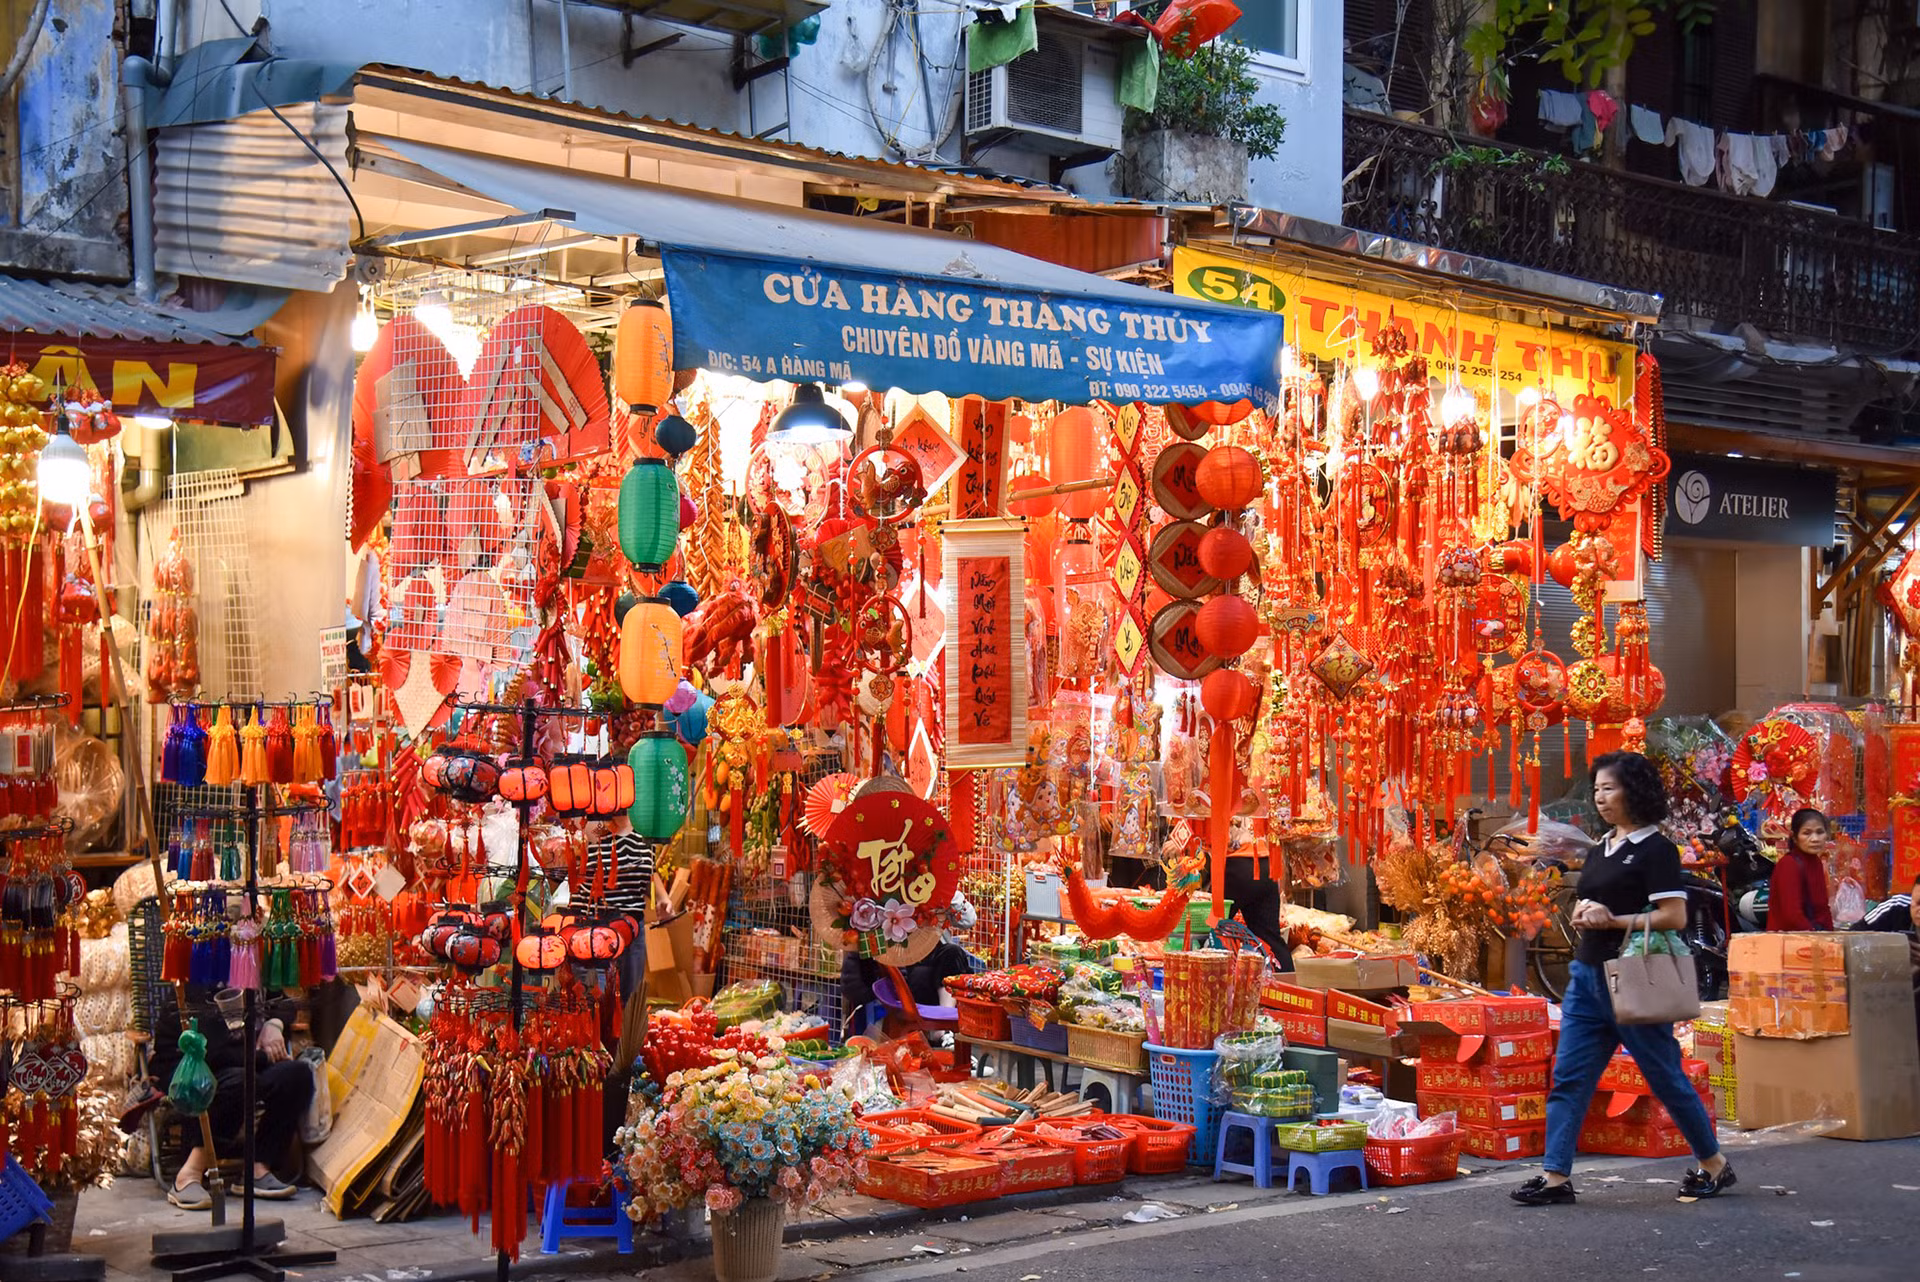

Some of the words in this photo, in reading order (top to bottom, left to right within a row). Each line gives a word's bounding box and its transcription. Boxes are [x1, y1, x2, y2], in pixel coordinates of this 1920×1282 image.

[763, 265, 851, 311] CỬA
[860, 279, 974, 323] HÀNG
[1202, 269, 1276, 311] 54
[1300, 295, 1495, 366] THANH
[708, 350, 738, 371] Đ/C:
[741, 355, 761, 373] 54
[766, 357, 777, 375] A
[781, 354, 826, 379] HÀNG
[829, 361, 852, 381] MÃ
[842, 325, 929, 359] CHUYÊN
[934, 327, 962, 362] ĐỒ
[967, 334, 1026, 367] VÀNG
[1030, 341, 1064, 370] MÃ
[1086, 345, 1112, 377] SỰ
[1117, 347, 1165, 380] KIỆN
[1089, 381, 1112, 398] ĐT:
[1114, 383, 1141, 399] 090
[1143, 384, 1170, 399] 322
[1172, 384, 1208, 400] 5454
[1220, 382, 1252, 397] 0945
[1500, 370, 1522, 383] 254
[1719, 492, 1790, 519] ATELIER
[856, 818, 937, 907] Tết
